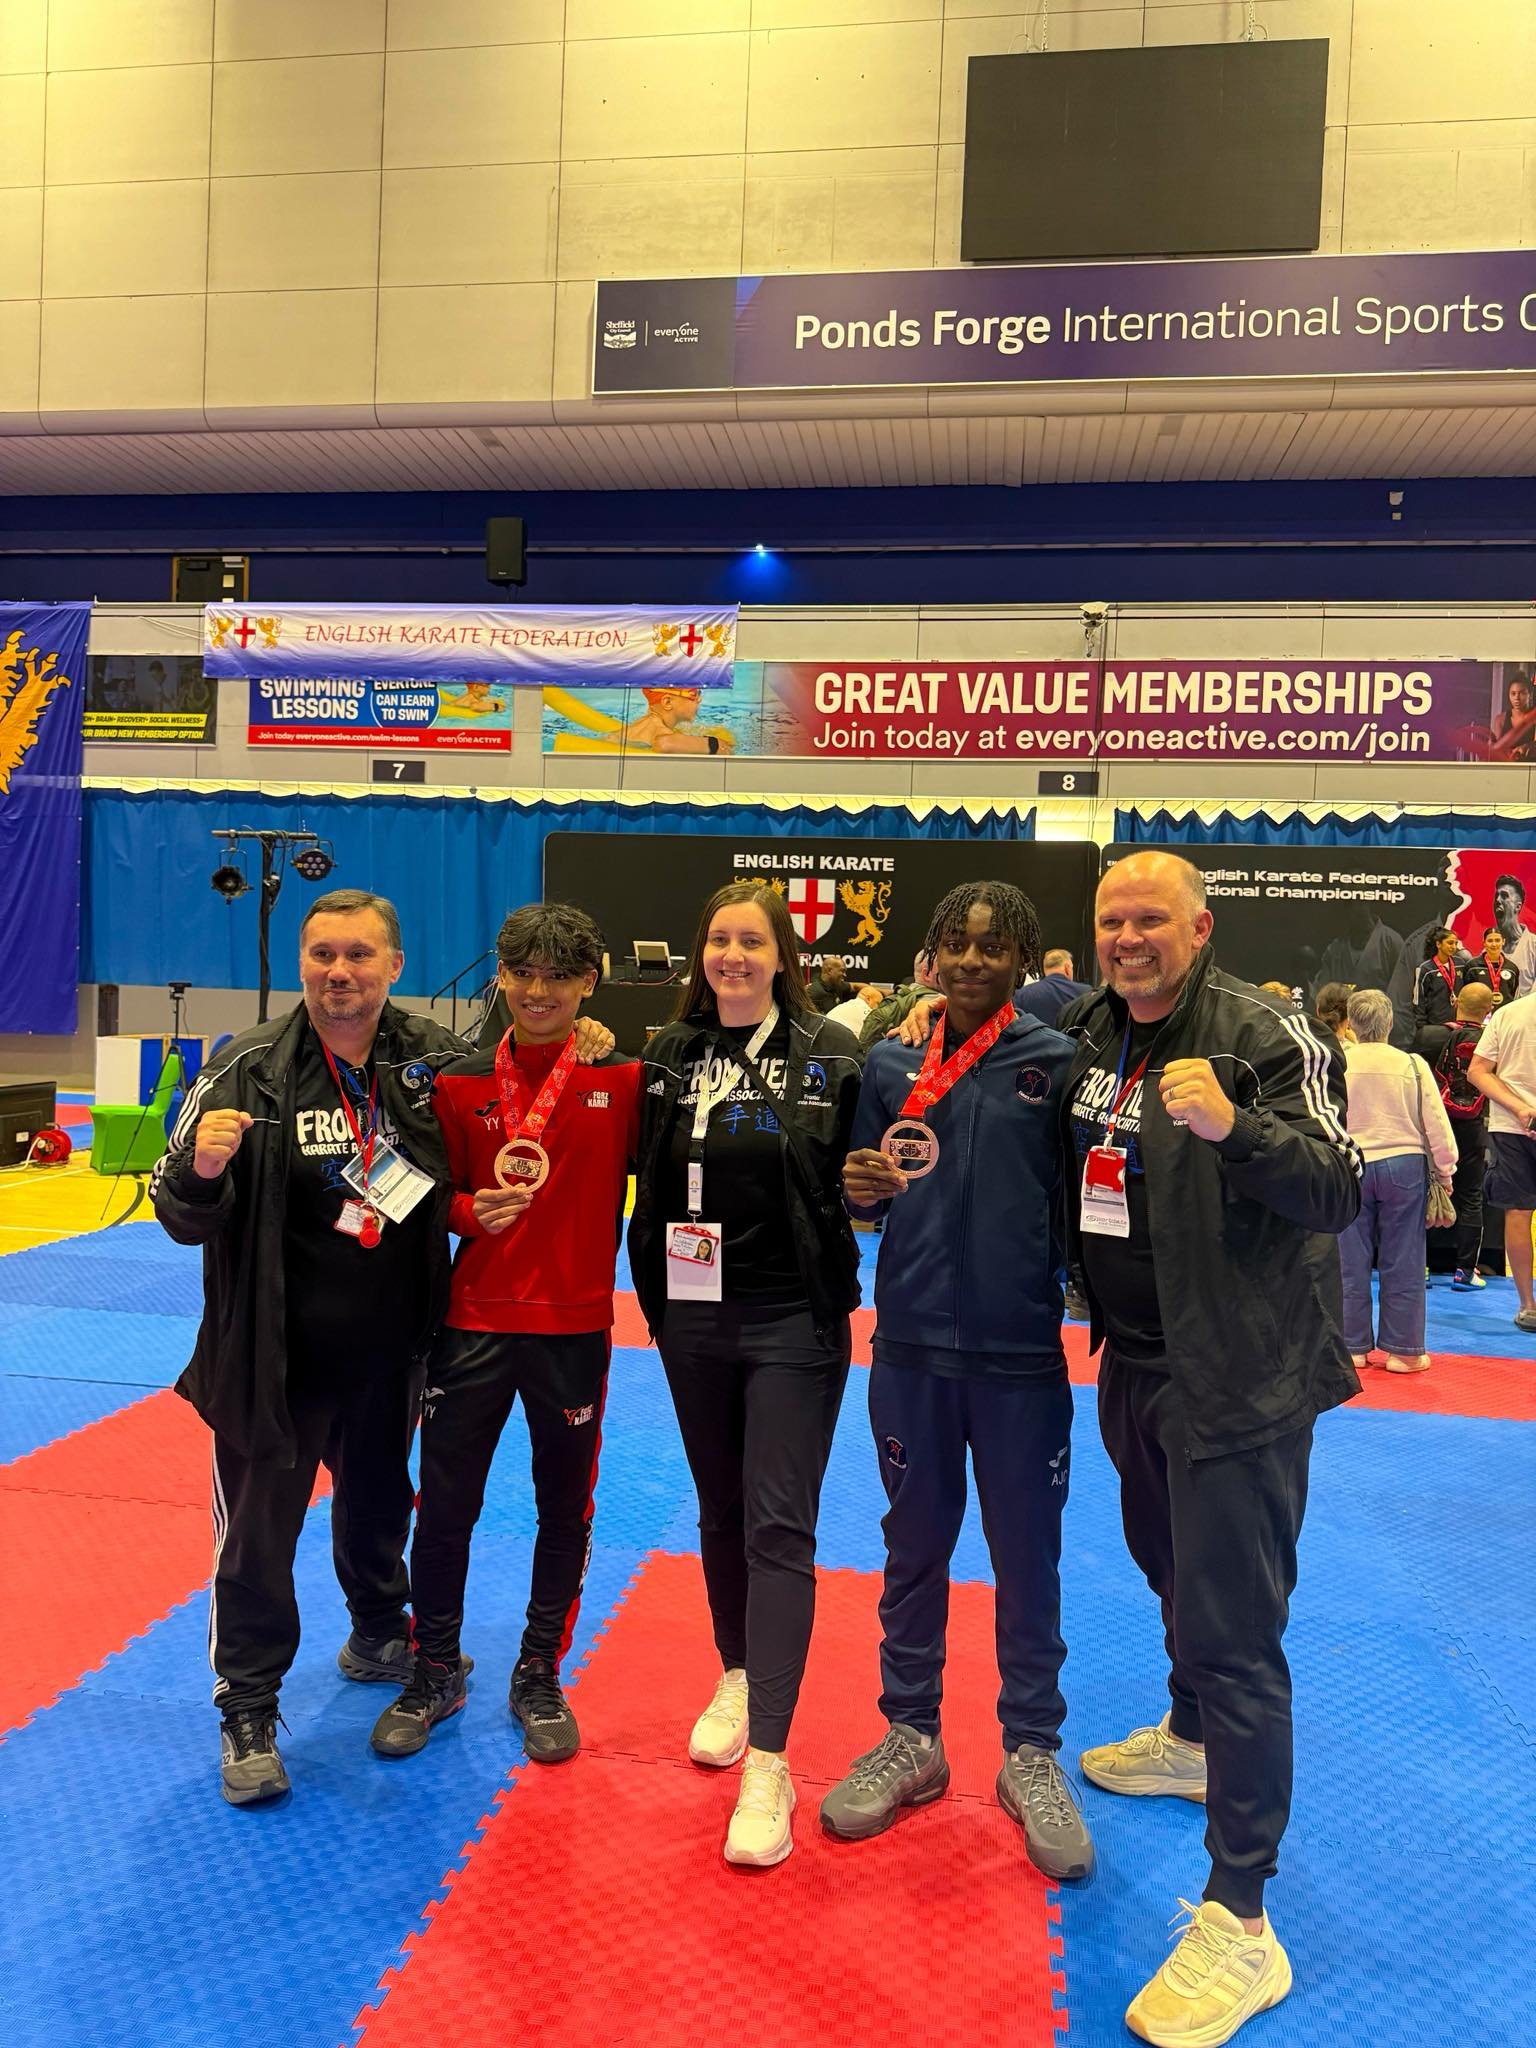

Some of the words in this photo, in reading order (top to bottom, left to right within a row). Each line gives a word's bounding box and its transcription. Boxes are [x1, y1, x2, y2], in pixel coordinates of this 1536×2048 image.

[605, 320, 636, 329] Sheffield
[654, 323, 699, 337] everyone
[795, 309, 921, 350] Ponds
[932, 309, 1051, 355] Forge
[1063, 296, 1341, 343] International
[1354, 295, 1504, 345] Sports
[305, 624, 393, 643] ENGLISH
[400, 626, 481, 645] KARATE
[489, 627, 627, 648] FEDERATION
[260, 679, 366, 698] SWIMMING
[815, 672, 948, 714] GREAT
[957, 672, 1090, 714] VALUE
[1103, 671, 1433, 716] MEMBERSHIPS
[376, 694, 398, 706] CAN
[400, 695, 434, 707] LEARN
[271, 698, 359, 720] LESSONS
[381, 708, 396, 720] TO
[398, 708, 429, 721] SWIM
[94, 729, 117, 738] BRAND
[118, 729, 134, 738] NEW
[135, 730, 178, 739] MEMBERSHIP
[178, 730, 204, 739] OPTION
[258, 731, 274, 739] Join
[275, 731, 295, 741] today
[296, 732, 419, 743] everyoneactive.com/swim-lessons
[437, 732, 472, 744] everyone
[472, 736, 502, 744] ACTIVE
[813, 721, 875, 749] Join
[885, 722, 970, 756] today
[978, 725, 1007, 750] at
[1015, 721, 1430, 758] everyoneactive.com/join
[392, 763, 406, 779] 7
[1061, 774, 1076, 791] 8
[733, 854, 814, 869] ENGLISH
[820, 856, 895, 872] KARATE
[1254, 870, 1323, 883] Karate
[1328, 872, 1439, 887] Federation
[1204, 884, 1260, 898] tional
[1265, 886, 1406, 904] Championship
[484, 1117, 500, 1131] YY
[301, 1142, 348, 1156] KARATE
